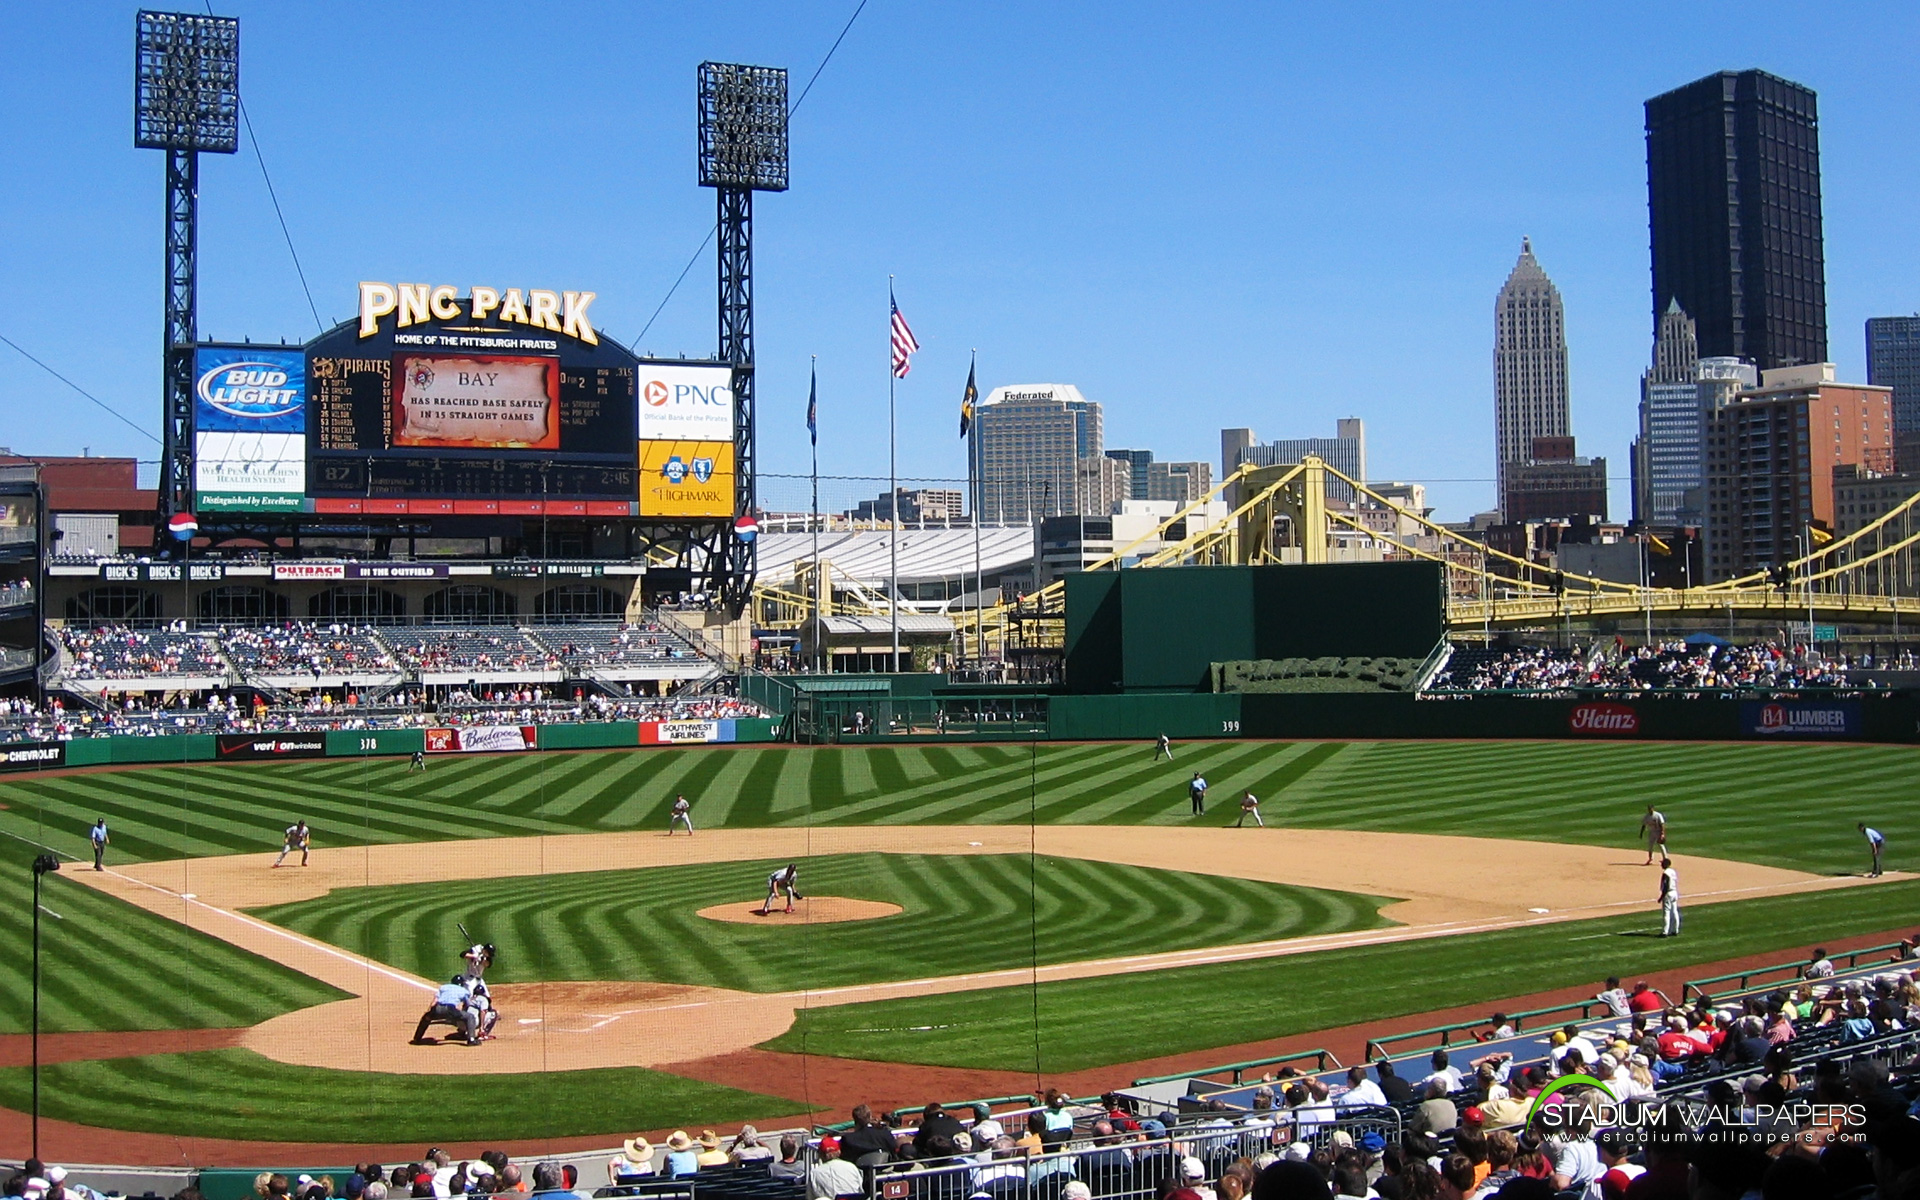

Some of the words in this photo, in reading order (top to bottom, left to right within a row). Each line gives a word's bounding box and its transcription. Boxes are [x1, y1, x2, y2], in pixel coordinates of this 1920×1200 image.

[359, 281, 462, 338] PNC
[471, 286, 598, 346] PARK
[395, 334, 423, 345] HOME
[424, 335, 437, 345] OF
[440, 336, 458, 346] THE
[459, 336, 518, 348] PITTSBURGH
[520, 340, 557, 350] PIRATES
[343, 358, 391, 380] PIRATES
[616, 368, 633, 376] .315
[226, 370, 288, 387] BUD
[458, 372, 499, 386] BAY
[579, 377, 585, 388] 2
[213, 388, 297, 404] LIGHT
[673, 384, 728, 406] PNC
[1004, 390, 1053, 400] Federated
[411, 397, 430, 405] HAS
[434, 398, 479, 406] REACHED
[482, 399, 507, 407] BASE
[510, 400, 544, 408] SAFELY
[420, 410, 431, 418] IN
[435, 411, 446, 419] 15
[450, 411, 498, 420] STRAIGHT
[501, 413, 535, 421] GAMES
[685, 413, 693, 421] of
[432, 458, 442, 470] 1
[325, 467, 351, 480] 87
[601, 472, 630, 485] 2:45
[202, 495, 251, 506] Distinguished
[252, 496, 260, 506] by
[261, 496, 299, 506] Excellence
[660, 489, 721, 501] HIGHMARK
[106, 566, 138, 577] DICK'S
[149, 566, 181, 577] DICK'S
[190, 566, 221, 577] DICK'S
[360, 568, 370, 576] IN
[372, 568, 389, 576] THE
[392, 568, 434, 577] OUTFIELD
[559, 566, 592, 574] MILLION
[1571, 708, 1636, 729] Heinz
[1763, 708, 1783, 725] 84
[1789, 710, 1845, 725] LUMBER
[1222, 720, 1240, 732] 399
[670, 731, 705, 739] AIRLINES
[253, 740, 294, 753] verizon
[294, 742, 322, 750] wireless
[360, 738, 376, 750] 378
[9, 748, 60, 762] CHEVROLET
